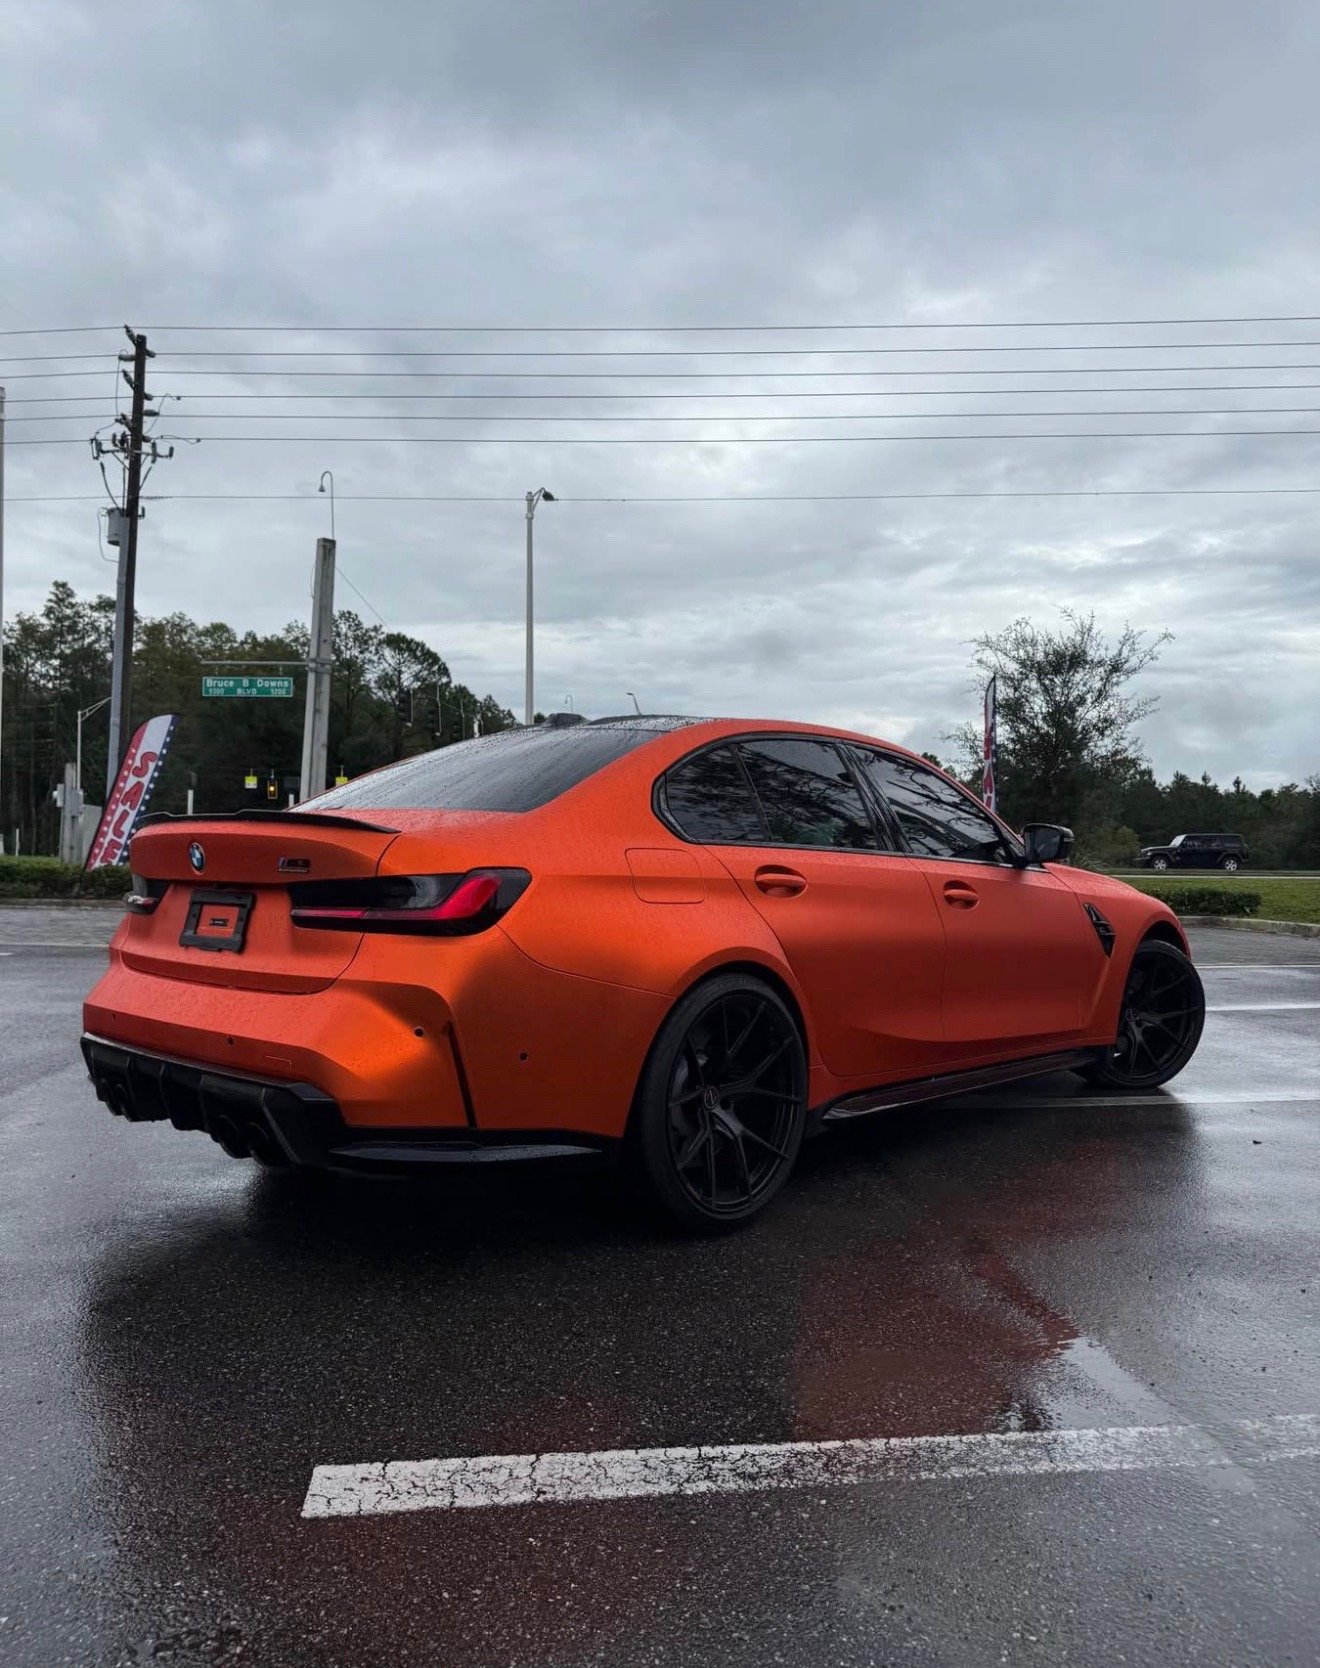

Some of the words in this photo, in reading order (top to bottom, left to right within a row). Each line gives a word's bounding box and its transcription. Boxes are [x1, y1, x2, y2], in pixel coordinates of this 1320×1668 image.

[206, 678, 235, 688] Bruce
[242, 679, 250, 688] B
[256, 679, 289, 688] Downs
[100, 751, 158, 864] SALE
